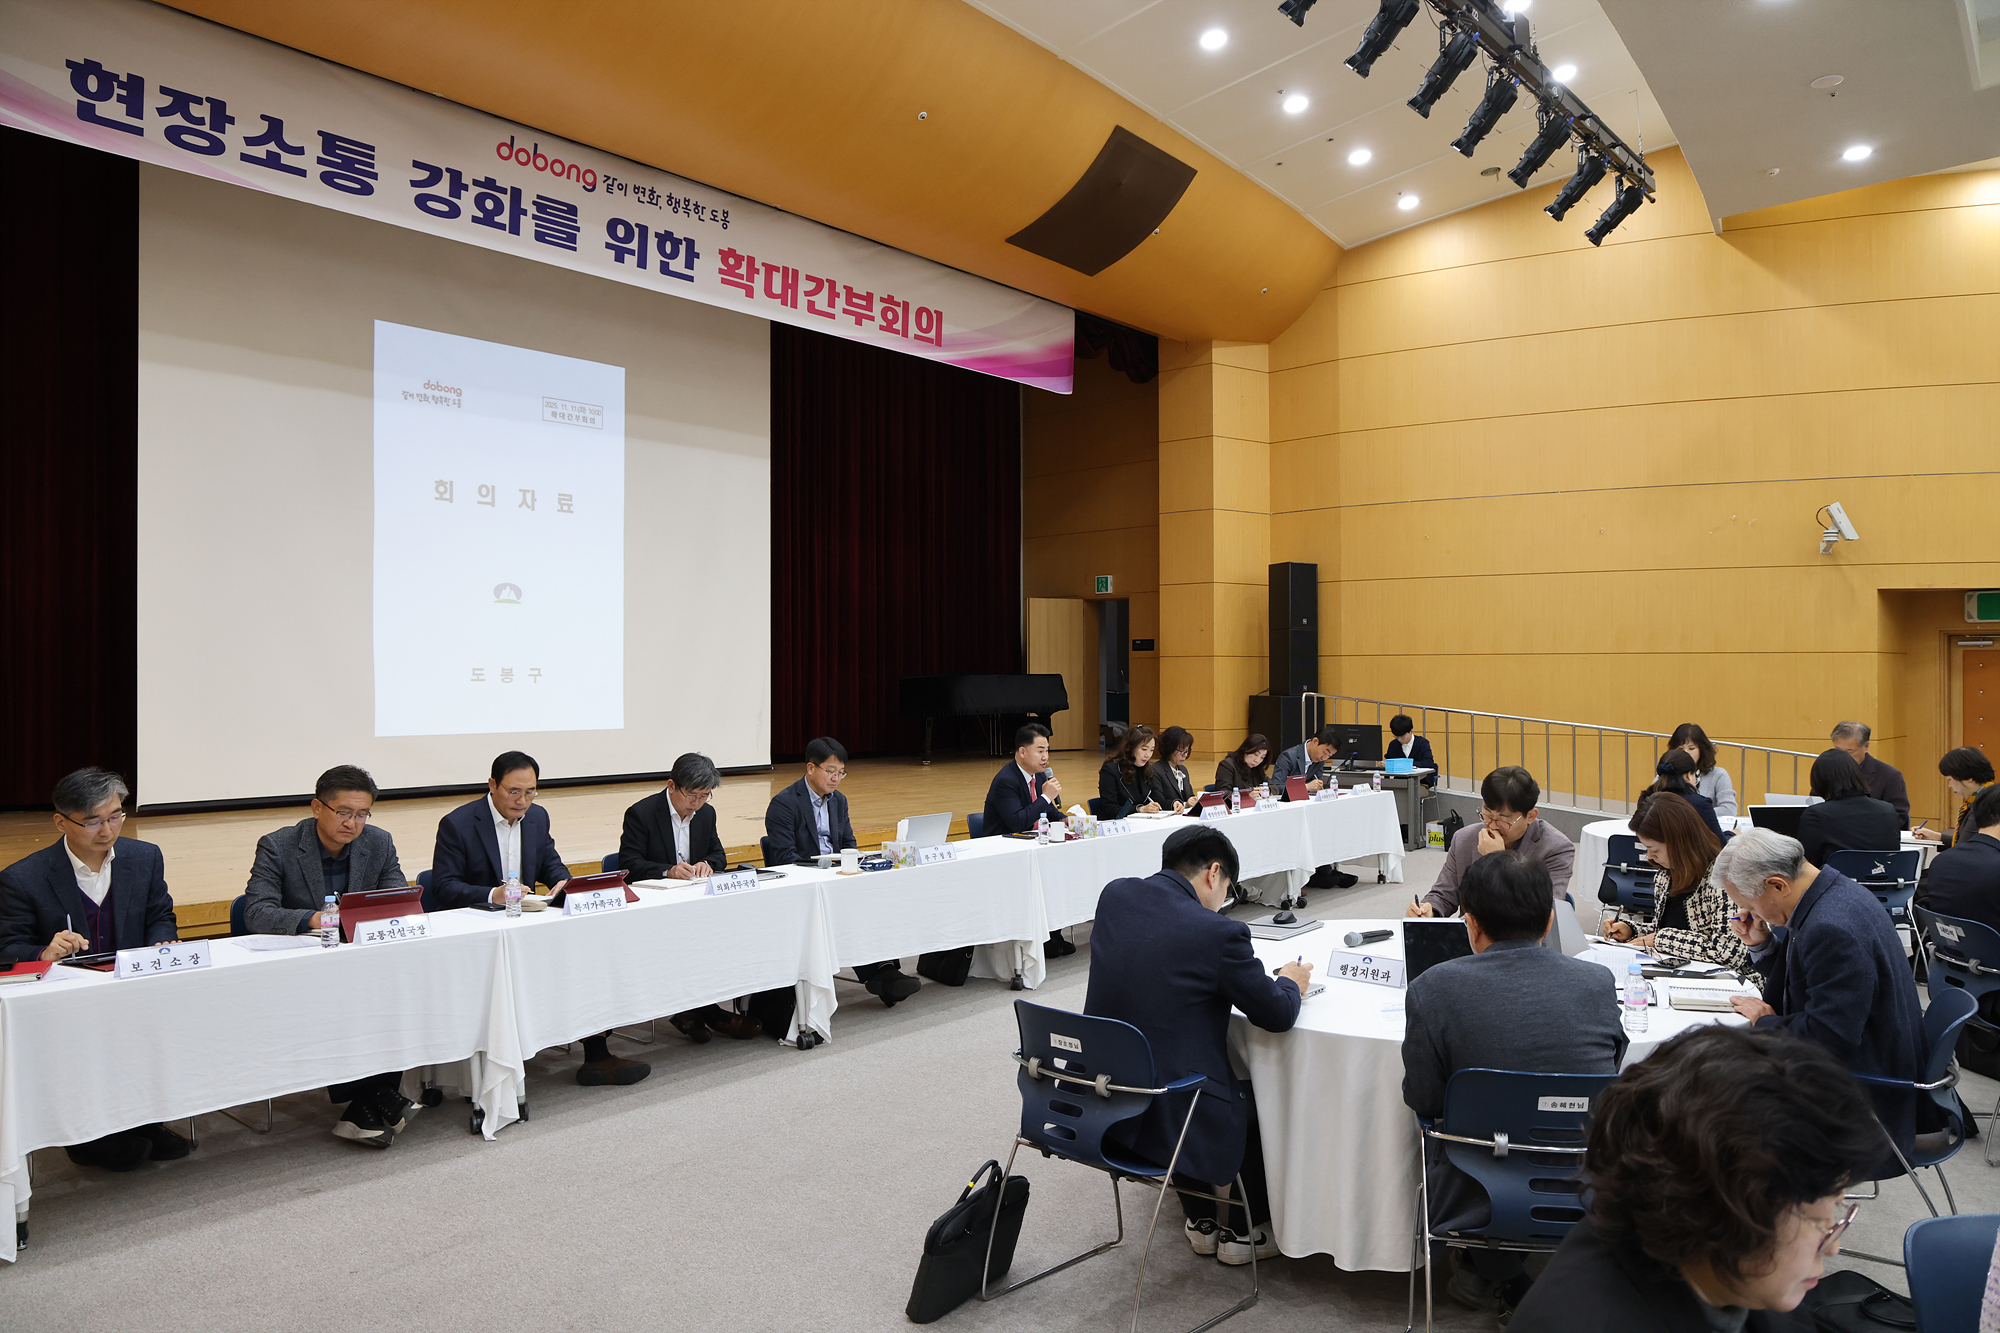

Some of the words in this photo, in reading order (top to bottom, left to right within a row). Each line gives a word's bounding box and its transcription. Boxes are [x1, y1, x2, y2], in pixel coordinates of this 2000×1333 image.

[495, 134, 598, 193] dobong
[64, 57, 379, 197] 현장소통
[408, 158, 582, 253] 강화를
[603, 216, 701, 284] 위한
[716, 246, 945, 348] 확대간부회의
[602, 174, 628, 197] 같이
[632, 183, 663, 211] 변화,
[666, 192, 707, 223] 행복한
[709, 208, 731, 230] 도봉
[423, 379, 463, 398] dobong
[550, 410, 596, 425] 확대간부회의
[470, 666, 543, 684] 도봉구
[716, 878, 756, 892] 의회사무국장
[574, 897, 622, 913] 복지가족국장
[366, 924, 426, 942] 교통건설국장
[130, 952, 201, 973] 보건소장
[1339, 963, 1392, 983] 행정지원과
